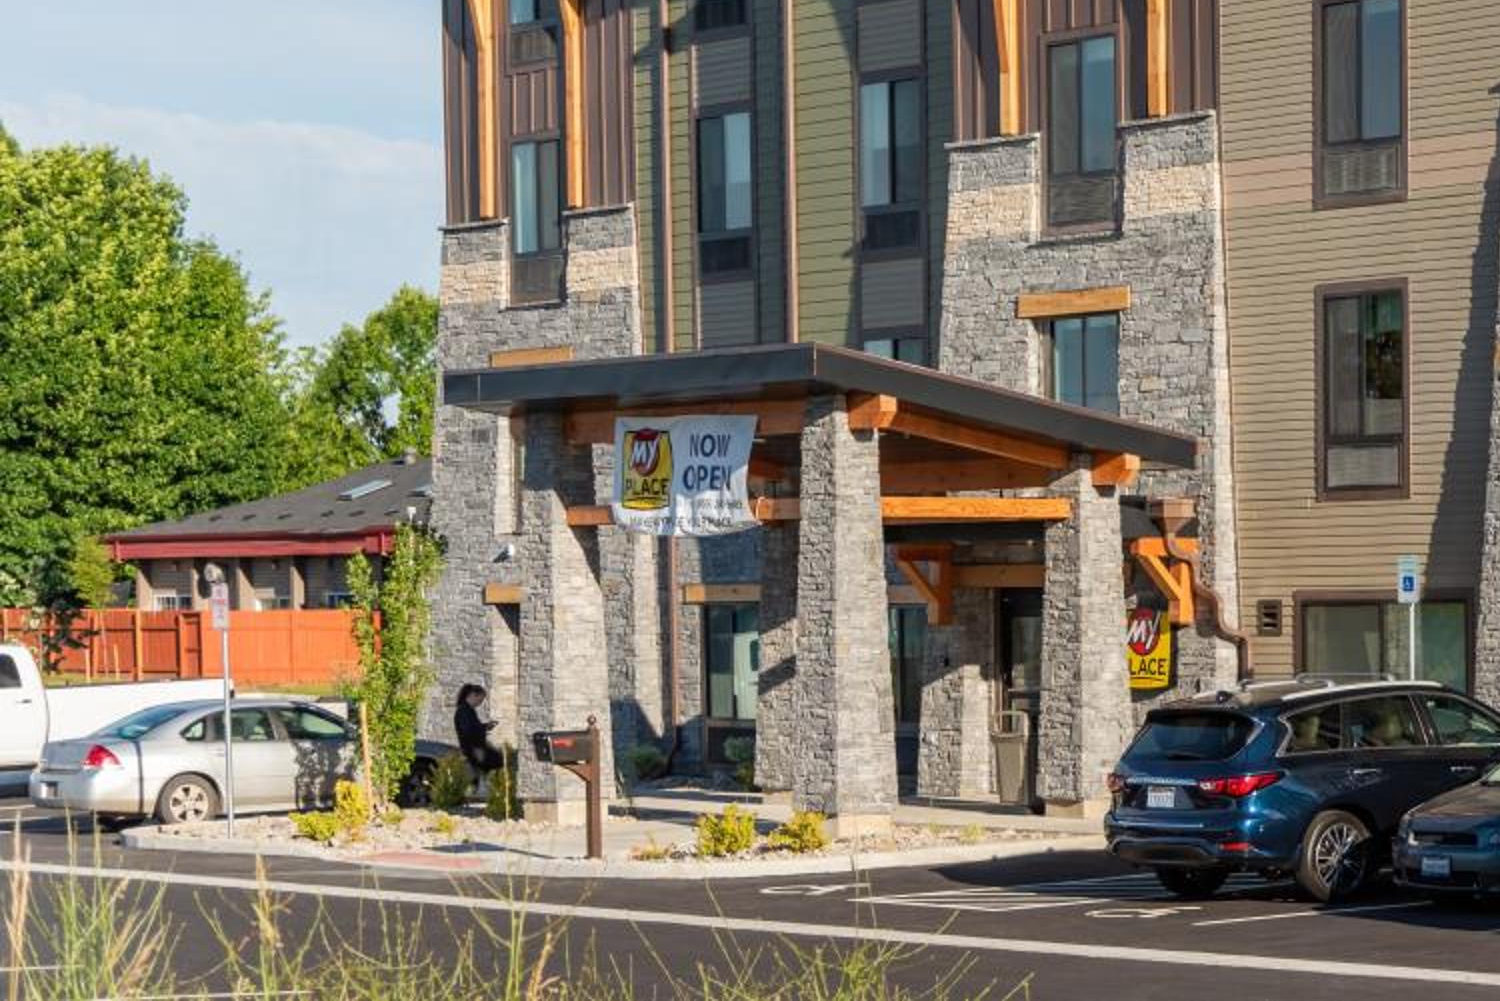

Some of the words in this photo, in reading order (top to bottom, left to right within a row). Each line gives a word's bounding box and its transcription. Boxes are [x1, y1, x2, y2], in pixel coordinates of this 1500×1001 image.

[690, 433, 731, 457] NOW
[625, 478, 669, 496] PLACE
[683, 465, 732, 490] OPEN
[1129, 658, 1167, 676] LACE
